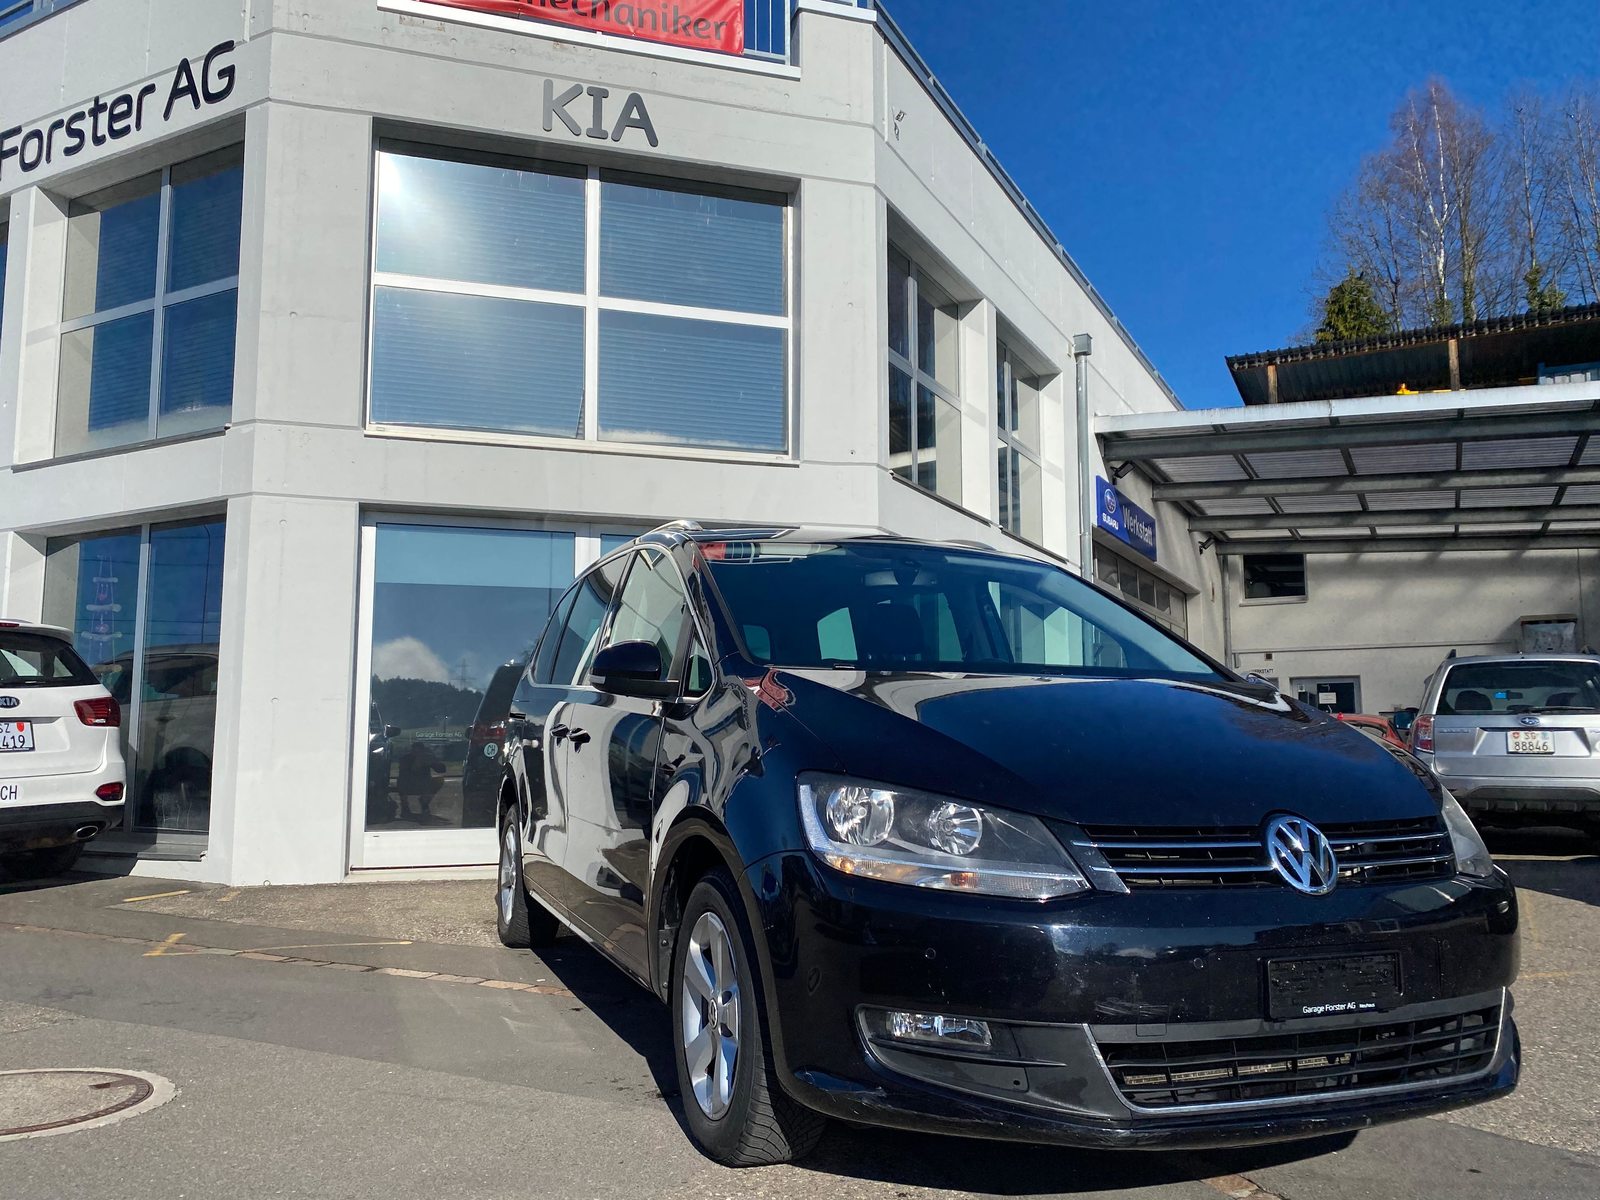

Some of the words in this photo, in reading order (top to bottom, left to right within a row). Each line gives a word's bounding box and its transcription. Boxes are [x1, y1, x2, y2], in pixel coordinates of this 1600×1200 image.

[513, 0, 728, 41] echaniker
[0, 83, 156, 181] Forster
[163, 39, 236, 121] AG
[542, 78, 659, 148] KIA
[1102, 512, 1119, 530] SUBARU
[1122, 505, 1153, 546] Werkstatt
[1524, 732, 1537, 740] SG
[1514, 741, 1549, 751] 88846
[0, 785, 18, 801] CH
[1302, 1006, 1324, 1014] Garage
[1325, 1003, 1346, 1011] Forster
